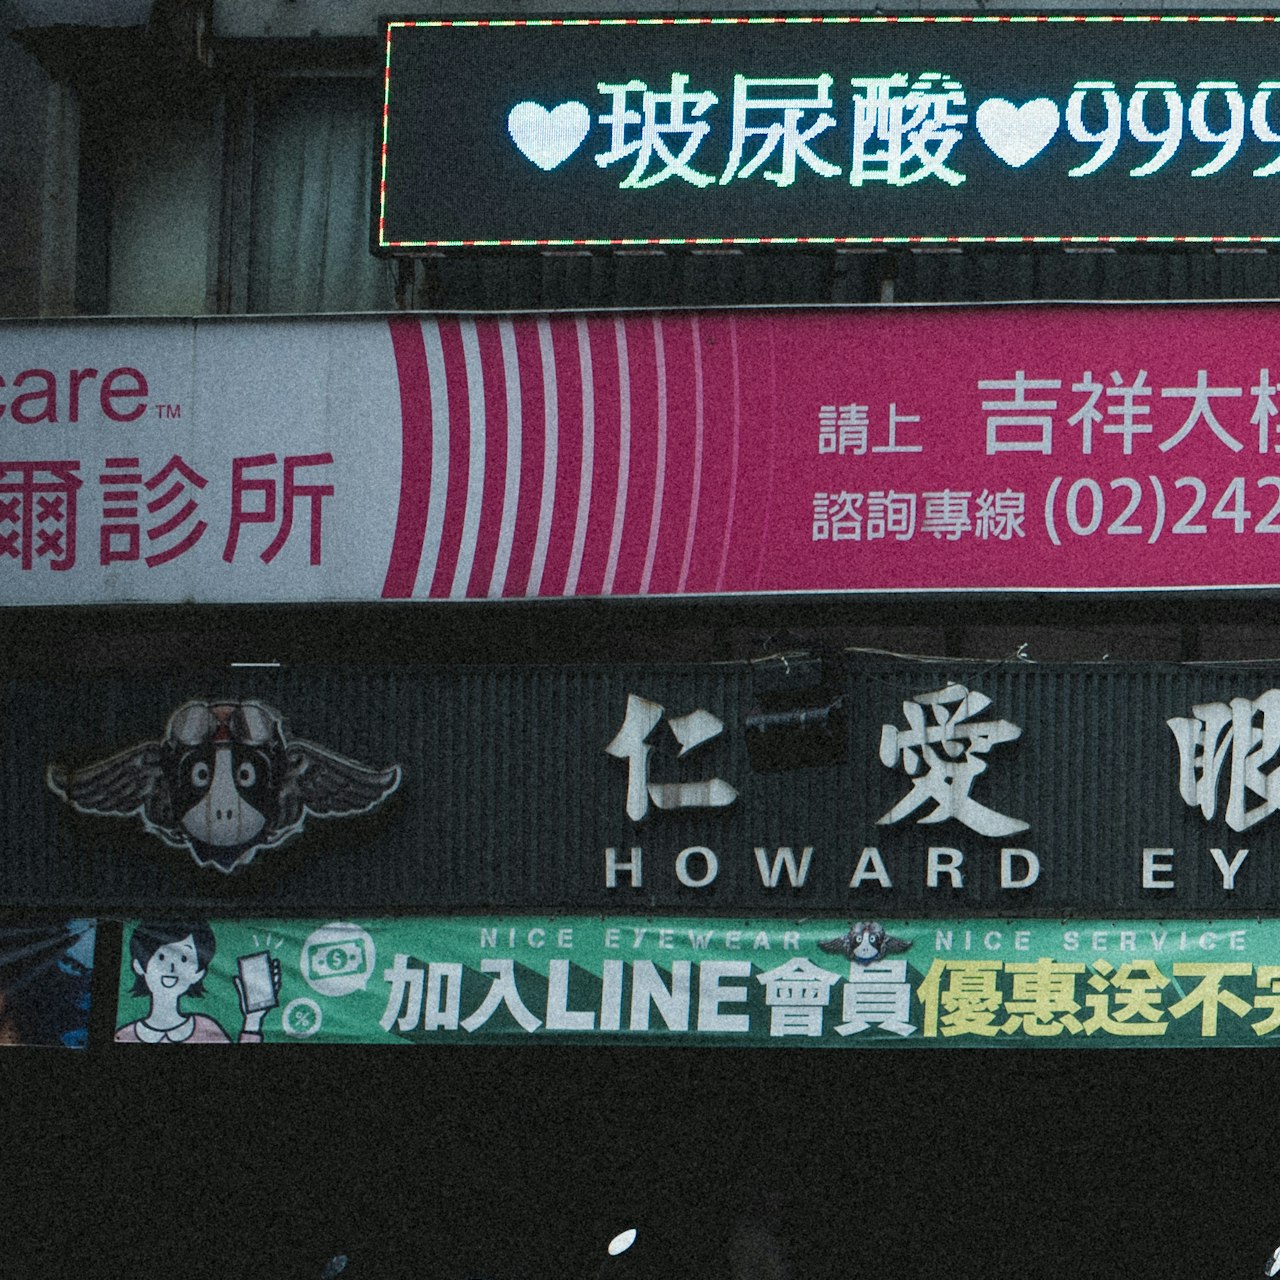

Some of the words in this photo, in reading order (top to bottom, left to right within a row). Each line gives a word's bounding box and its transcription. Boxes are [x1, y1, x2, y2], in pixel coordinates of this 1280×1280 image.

[595, 72, 968, 189] 玻尿酸
[0, 366, 149, 424] are
[818, 403, 923, 456] 請上
[0, 453, 335, 571] 爾診所
[812, 488, 1026, 542] 諮詢專線
[606, 847, 1041, 890] HOWARD
[480, 928, 573, 949] NICE
[605, 928, 801, 950] EYEWEAR
[935, 930, 1032, 952] NICE
[1063, 929, 1250, 953] SERVICE
